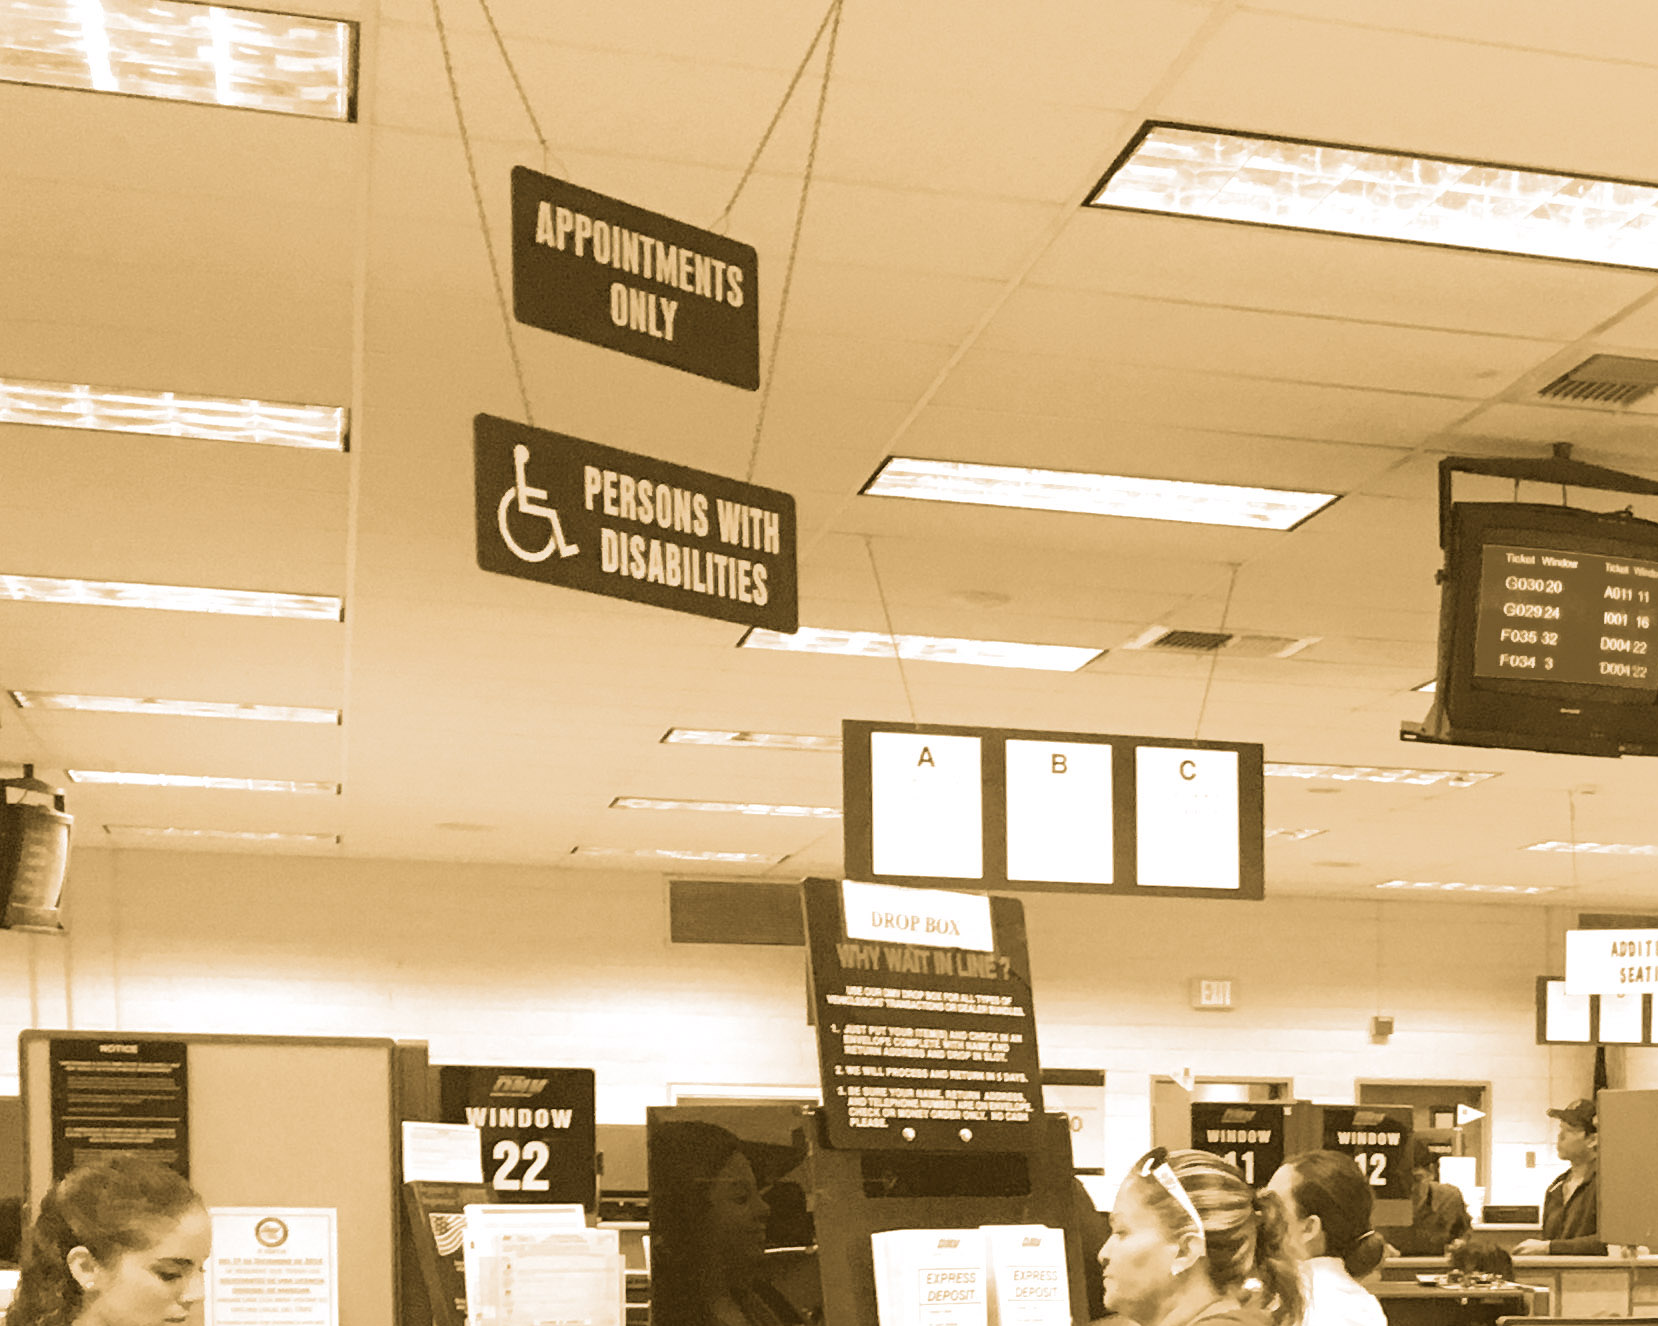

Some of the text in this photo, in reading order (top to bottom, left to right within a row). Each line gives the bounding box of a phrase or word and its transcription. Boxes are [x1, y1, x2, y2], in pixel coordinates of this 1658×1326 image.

[536, 200, 744, 308] APPOINTMENTS
[610, 282, 678, 341] ONLY
[583, 465, 781, 555] PERSONS WITH
[600, 529, 769, 606] DISABILITIES
[1506, 553, 1578, 569] Ticket Window
[1605, 562, 1629, 574] Ticket
[1505, 576, 1562, 594] G030 20
[1604, 586, 1650, 603] A011 11
[1503, 602, 1560, 620] G029 24
[1500, 628, 1558, 646] F035 32
[1633, 641, 1647, 654] 22
[1499, 653, 1554, 670] F034 3
[1632, 665, 1648, 678] 22
[917, 746, 935, 767] A
[1051, 754, 1067, 774] B
[1179, 760, 1196, 781] C
[872, 911, 960, 936] DROP BOX
[835, 943, 880, 970] WHY
[883, 947, 930, 974] WAIT
[933, 951, 953, 976] IN
[465, 1107, 572, 1129] WINDOW
[1207, 1129, 1271, 1143] WINDOW
[1337, 1131, 1400, 1146] WINDOW
[491, 1140, 550, 1191] 22
[1354, 1153, 1387, 1186] 12
[927, 1272, 976, 1285] EXPRESS
[1014, 1270, 1057, 1281] EXPRESS
[928, 1289, 976, 1302] DEPOSIT
[1015, 1287, 1058, 1298] DEPOSIT
